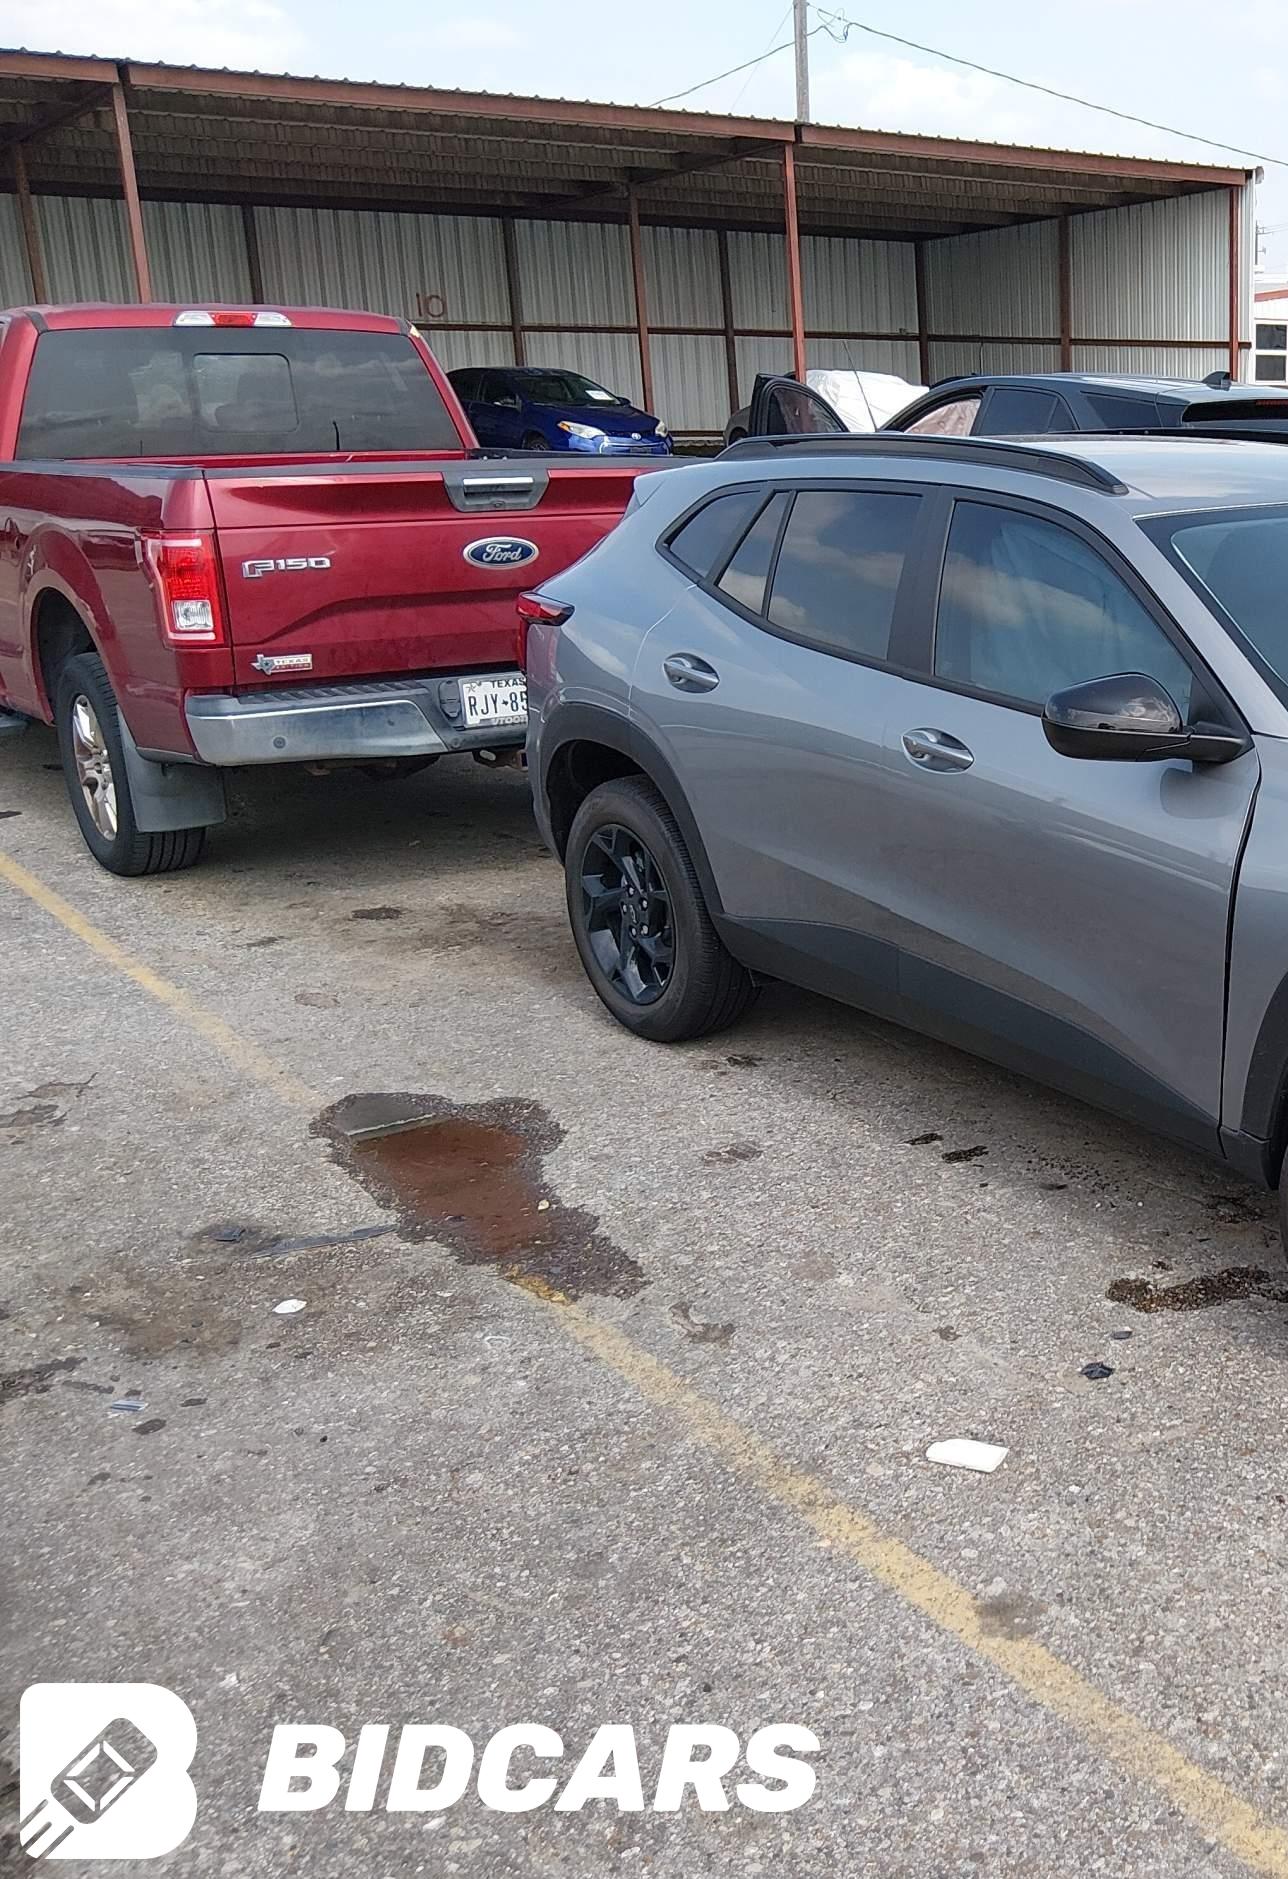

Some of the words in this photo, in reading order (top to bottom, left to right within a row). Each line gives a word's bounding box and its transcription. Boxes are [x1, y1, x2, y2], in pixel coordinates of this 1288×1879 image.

[416, 292, 448, 318] 10
[482, 543, 523, 562] Ford
[490, 678, 527, 689] TEXAS
